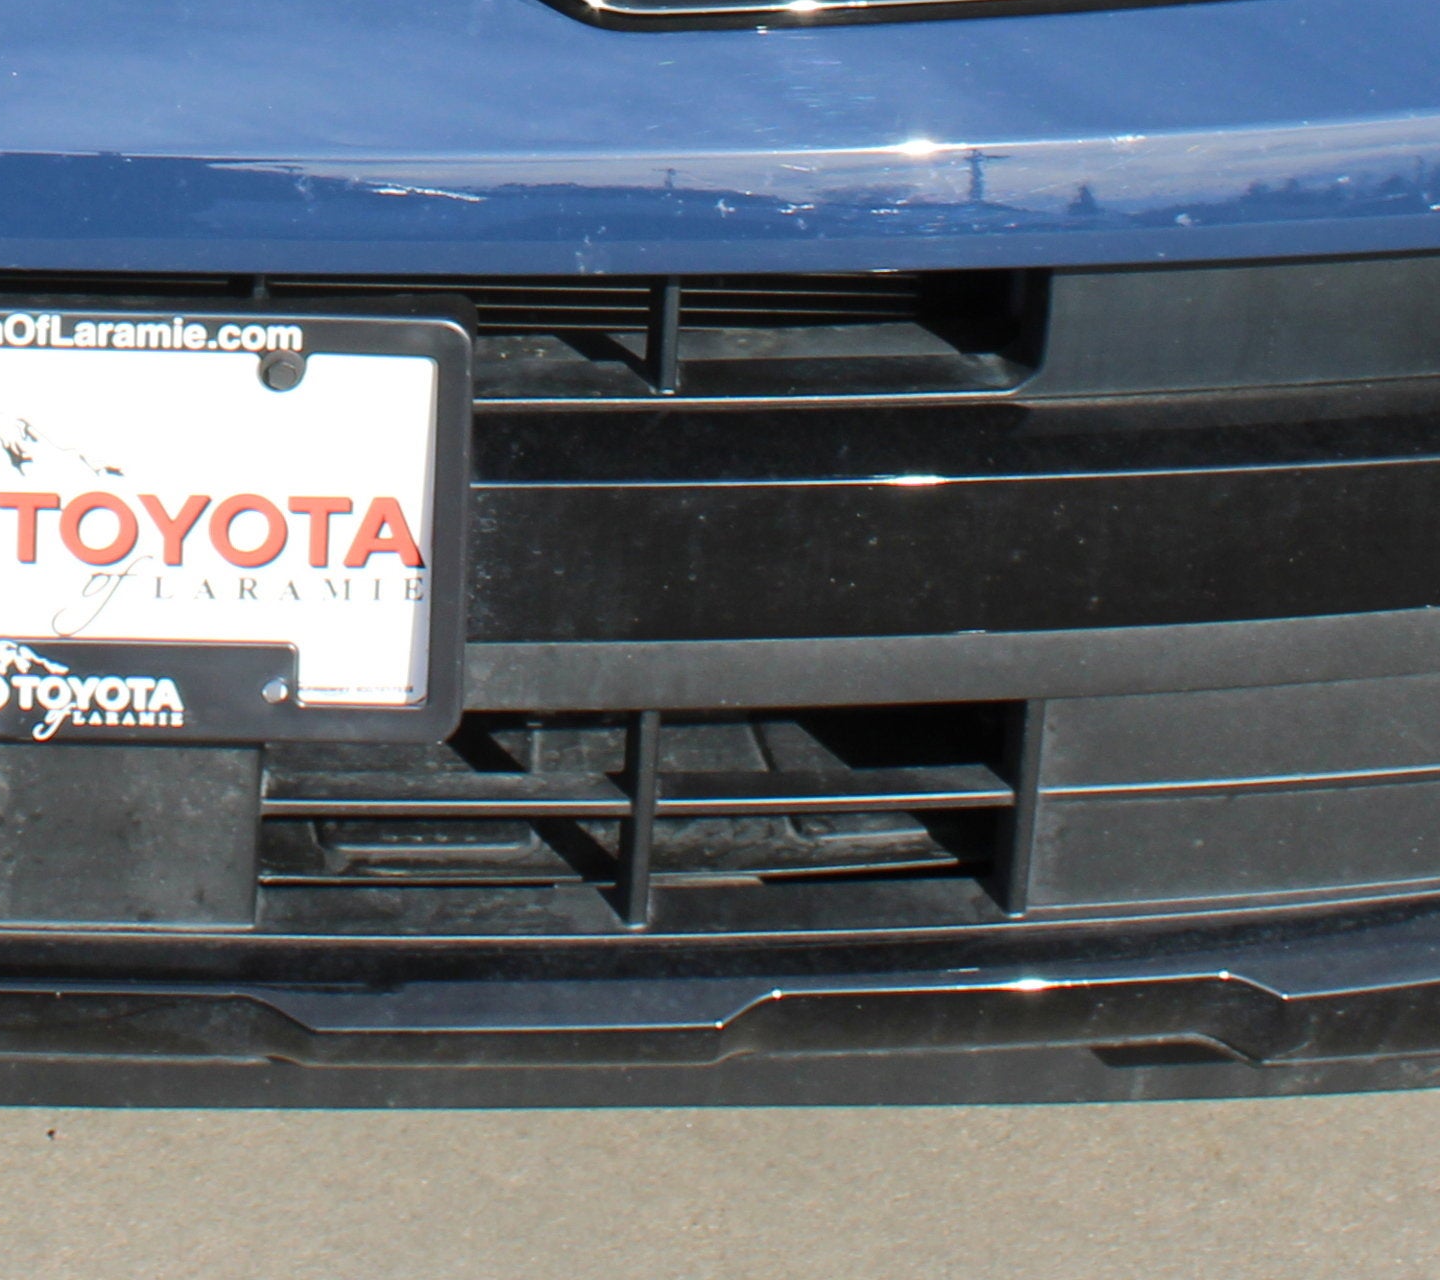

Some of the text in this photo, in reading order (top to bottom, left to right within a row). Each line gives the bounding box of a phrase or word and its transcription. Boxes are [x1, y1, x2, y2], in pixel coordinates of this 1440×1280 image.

[51, 554, 426, 638] of LARAMIE
[11, 673, 185, 713] TOYOTA
[71, 709, 185, 728] LARAMIE
